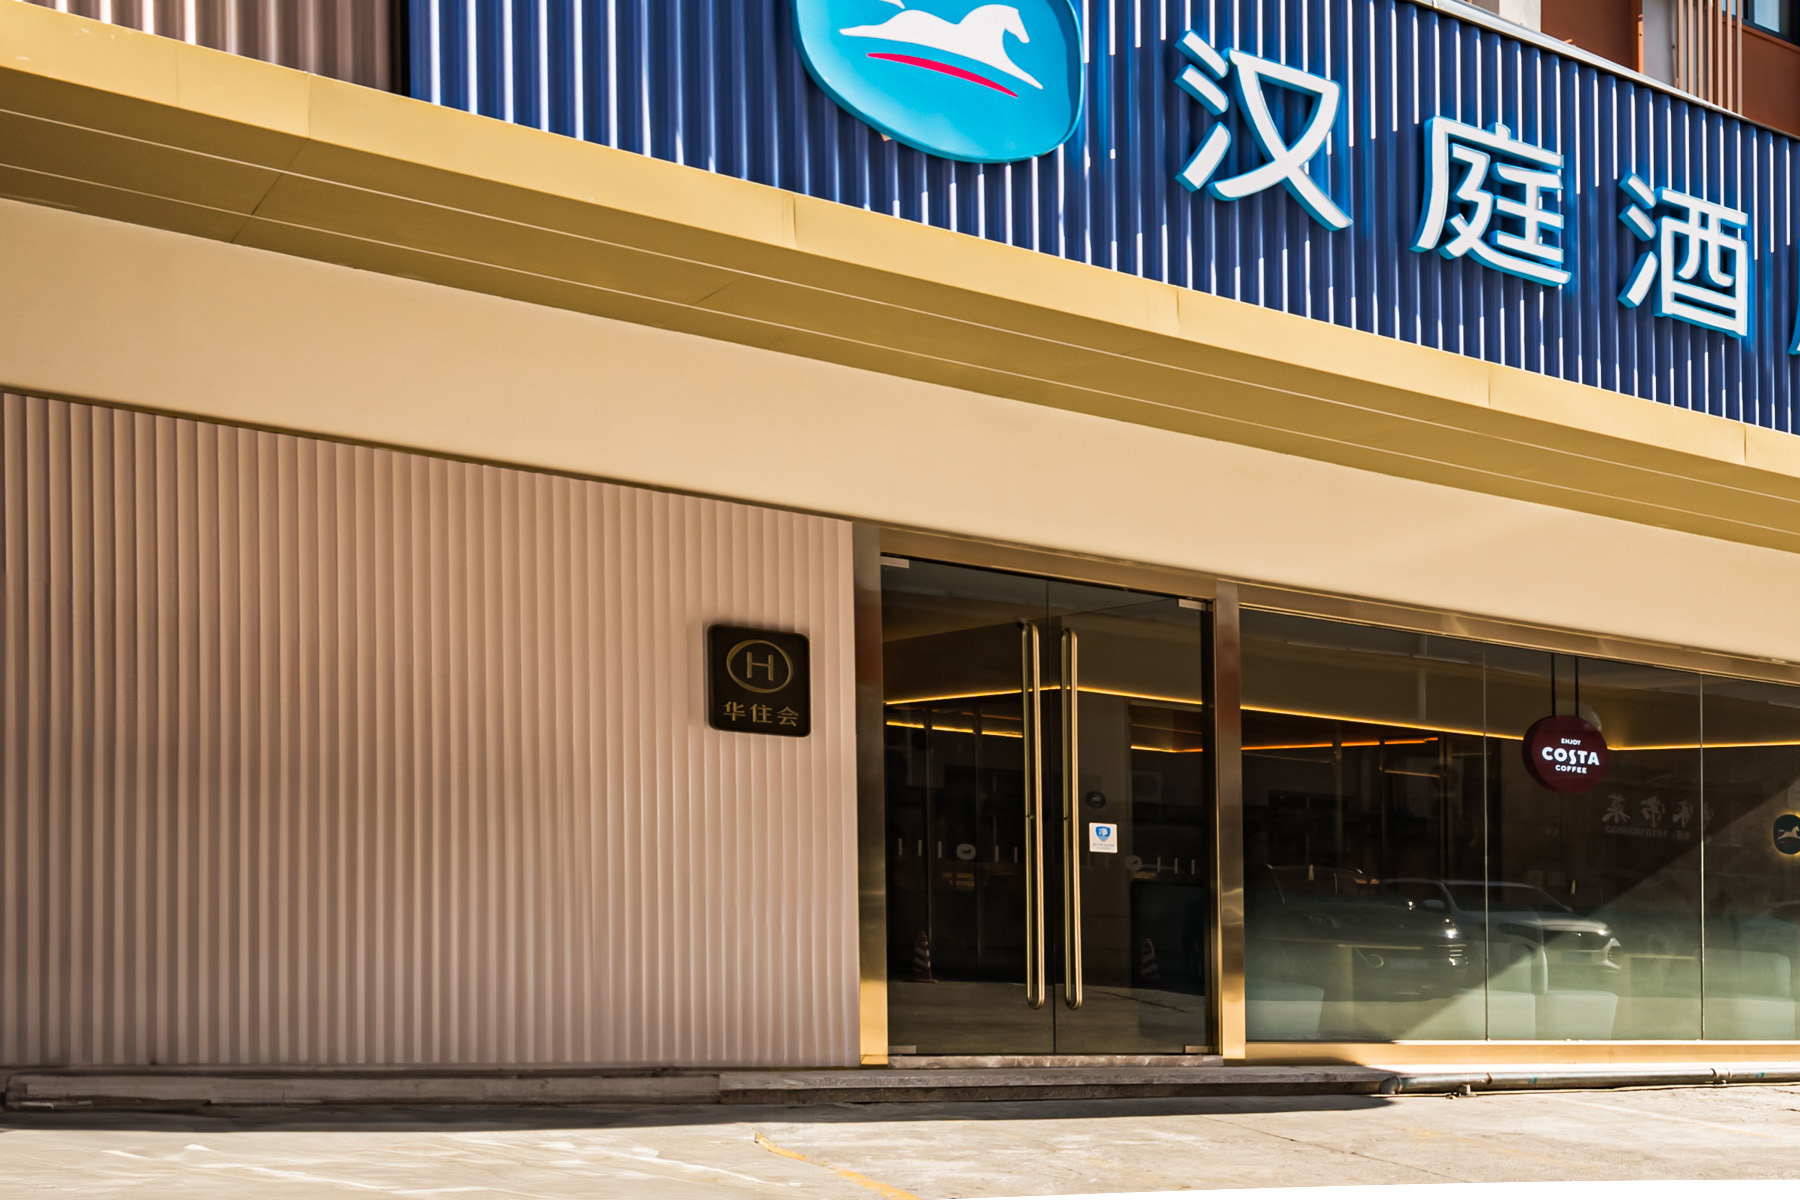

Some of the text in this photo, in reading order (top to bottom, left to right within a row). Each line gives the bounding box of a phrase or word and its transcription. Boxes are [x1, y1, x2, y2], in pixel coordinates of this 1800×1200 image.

[723, 701, 799, 726] 华住会
[1561, 738, 1581, 746] ENJOY
[1541, 746, 1600, 766] COSTA
[1555, 765, 1587, 775] COFFEE
